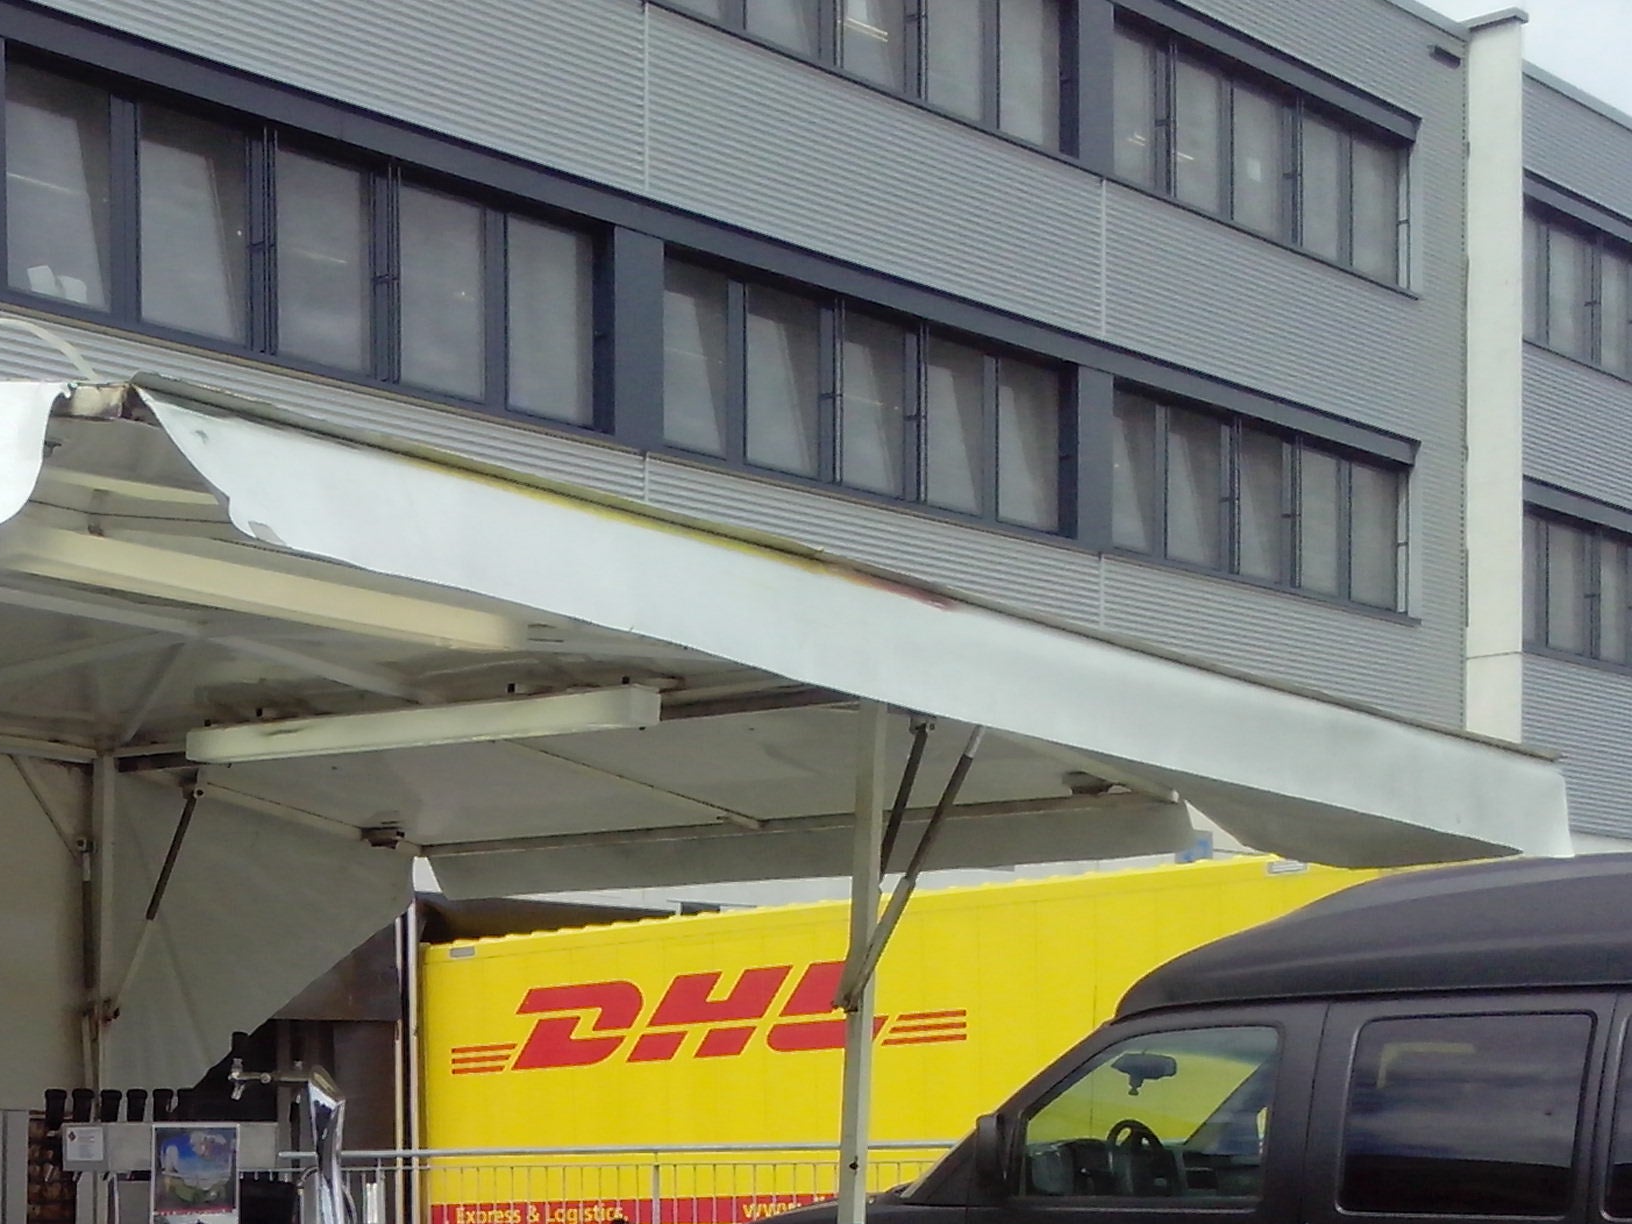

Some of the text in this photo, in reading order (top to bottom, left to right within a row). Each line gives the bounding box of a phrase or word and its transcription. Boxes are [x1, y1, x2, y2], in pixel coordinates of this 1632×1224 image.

[509, 960, 887, 1071] DHL
[455, 1206, 522, 1224] Express
[526, 1204, 540, 1222] &
